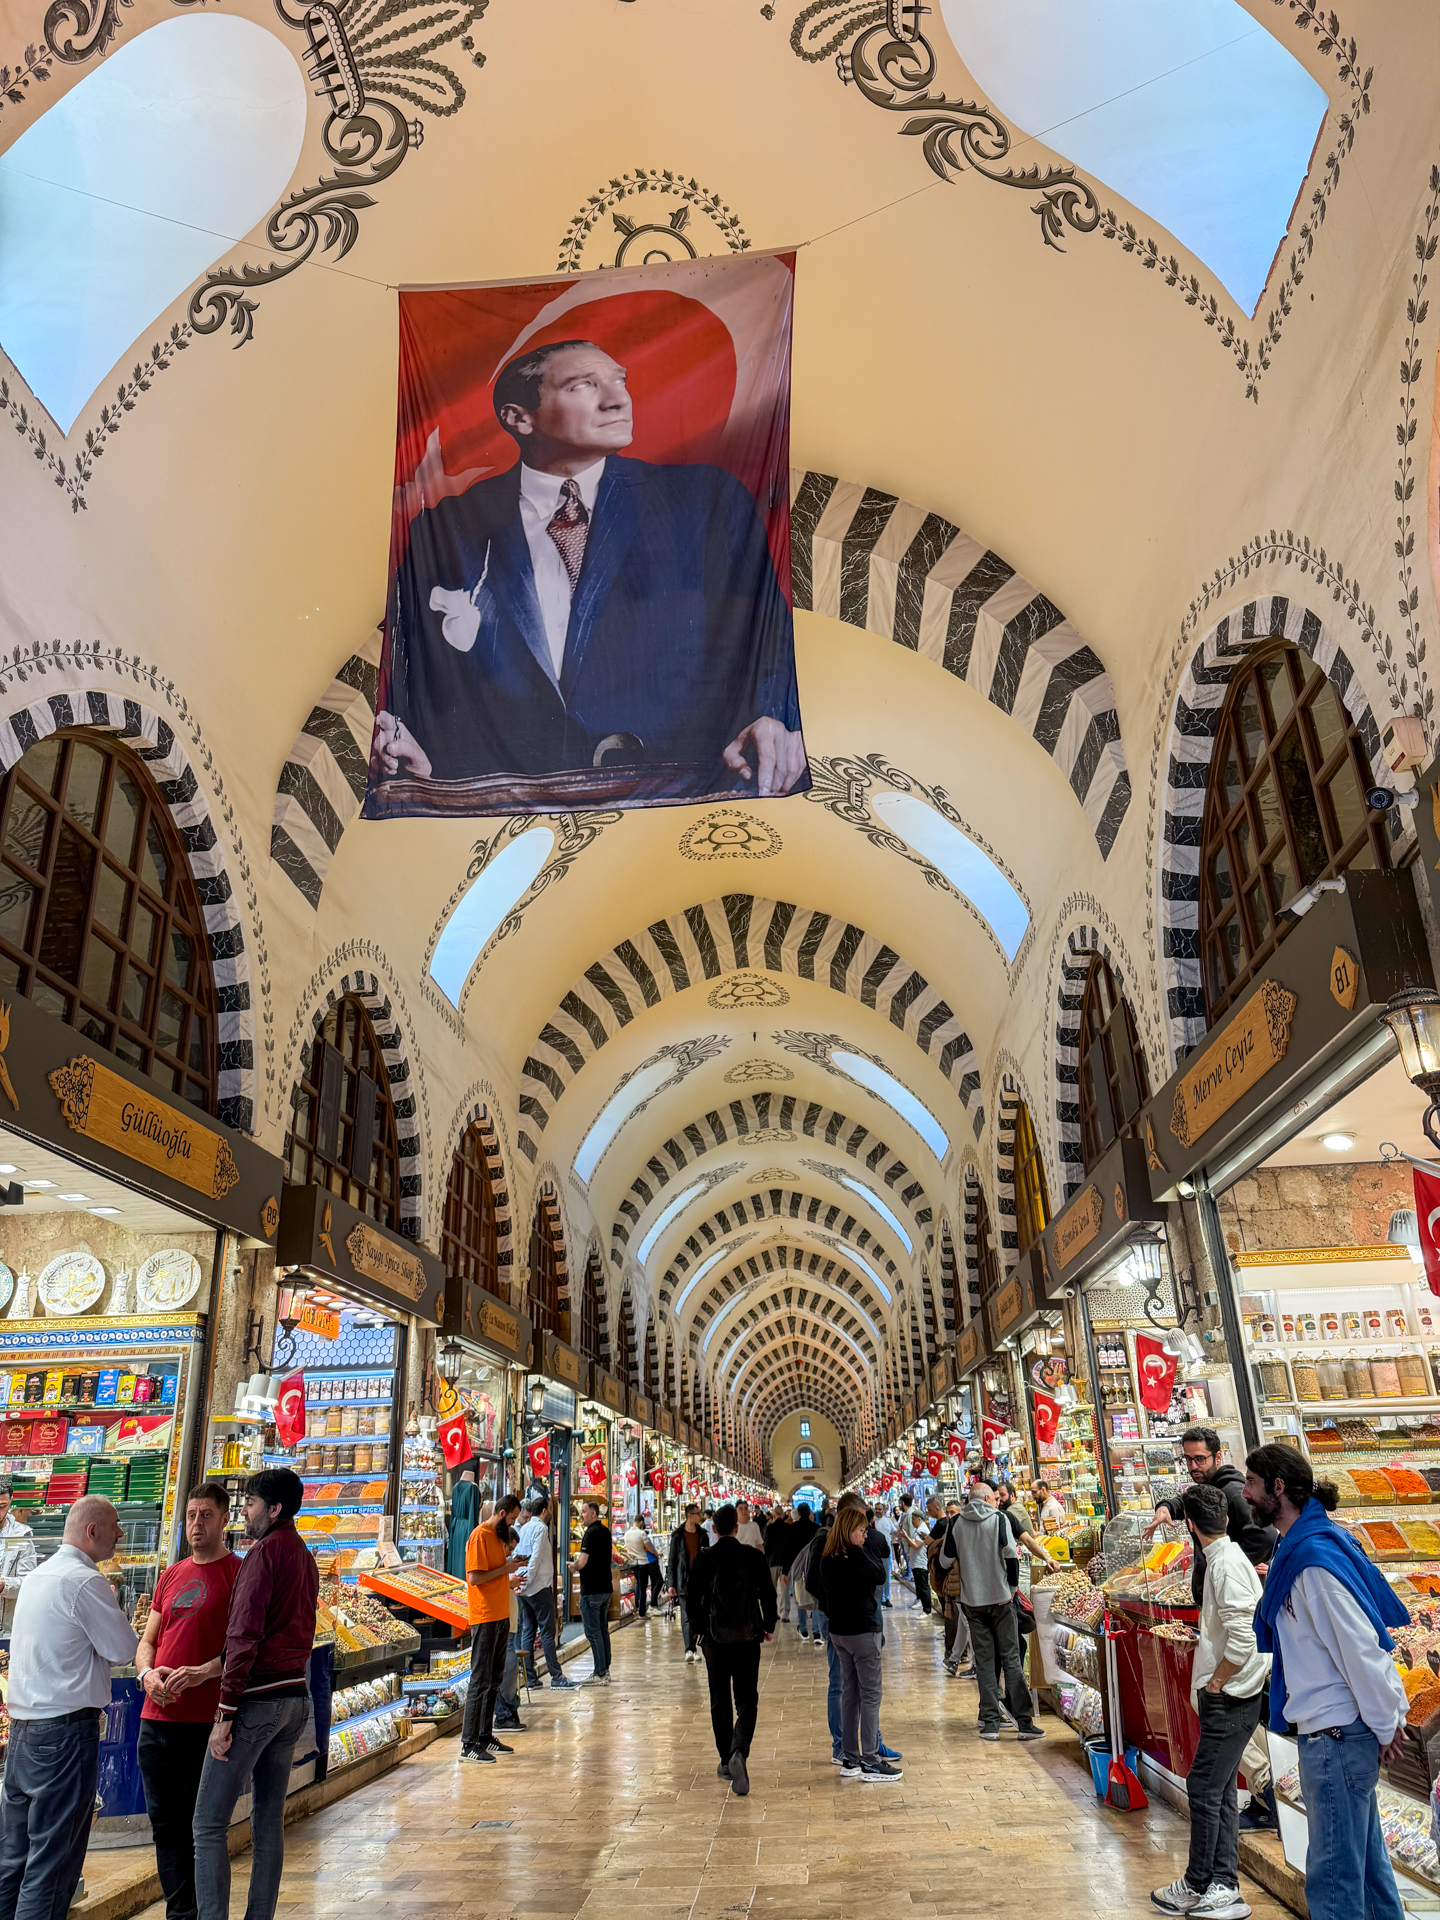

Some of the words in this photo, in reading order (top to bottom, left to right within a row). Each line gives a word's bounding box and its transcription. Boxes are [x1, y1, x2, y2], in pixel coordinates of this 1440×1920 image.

[1334, 961, 1350, 995] 81
[1193, 1063, 1224, 1110] Merve
[1224, 1028, 1255, 1080] Çeyiz
[121, 1102, 192, 1159] Güllüoğlu
[266, 1206, 277, 1226] 88
[366, 1241, 384, 1268] Saygı
[384, 1252, 399, 1273] Spice
[401, 1262, 414, 1286] Shop
